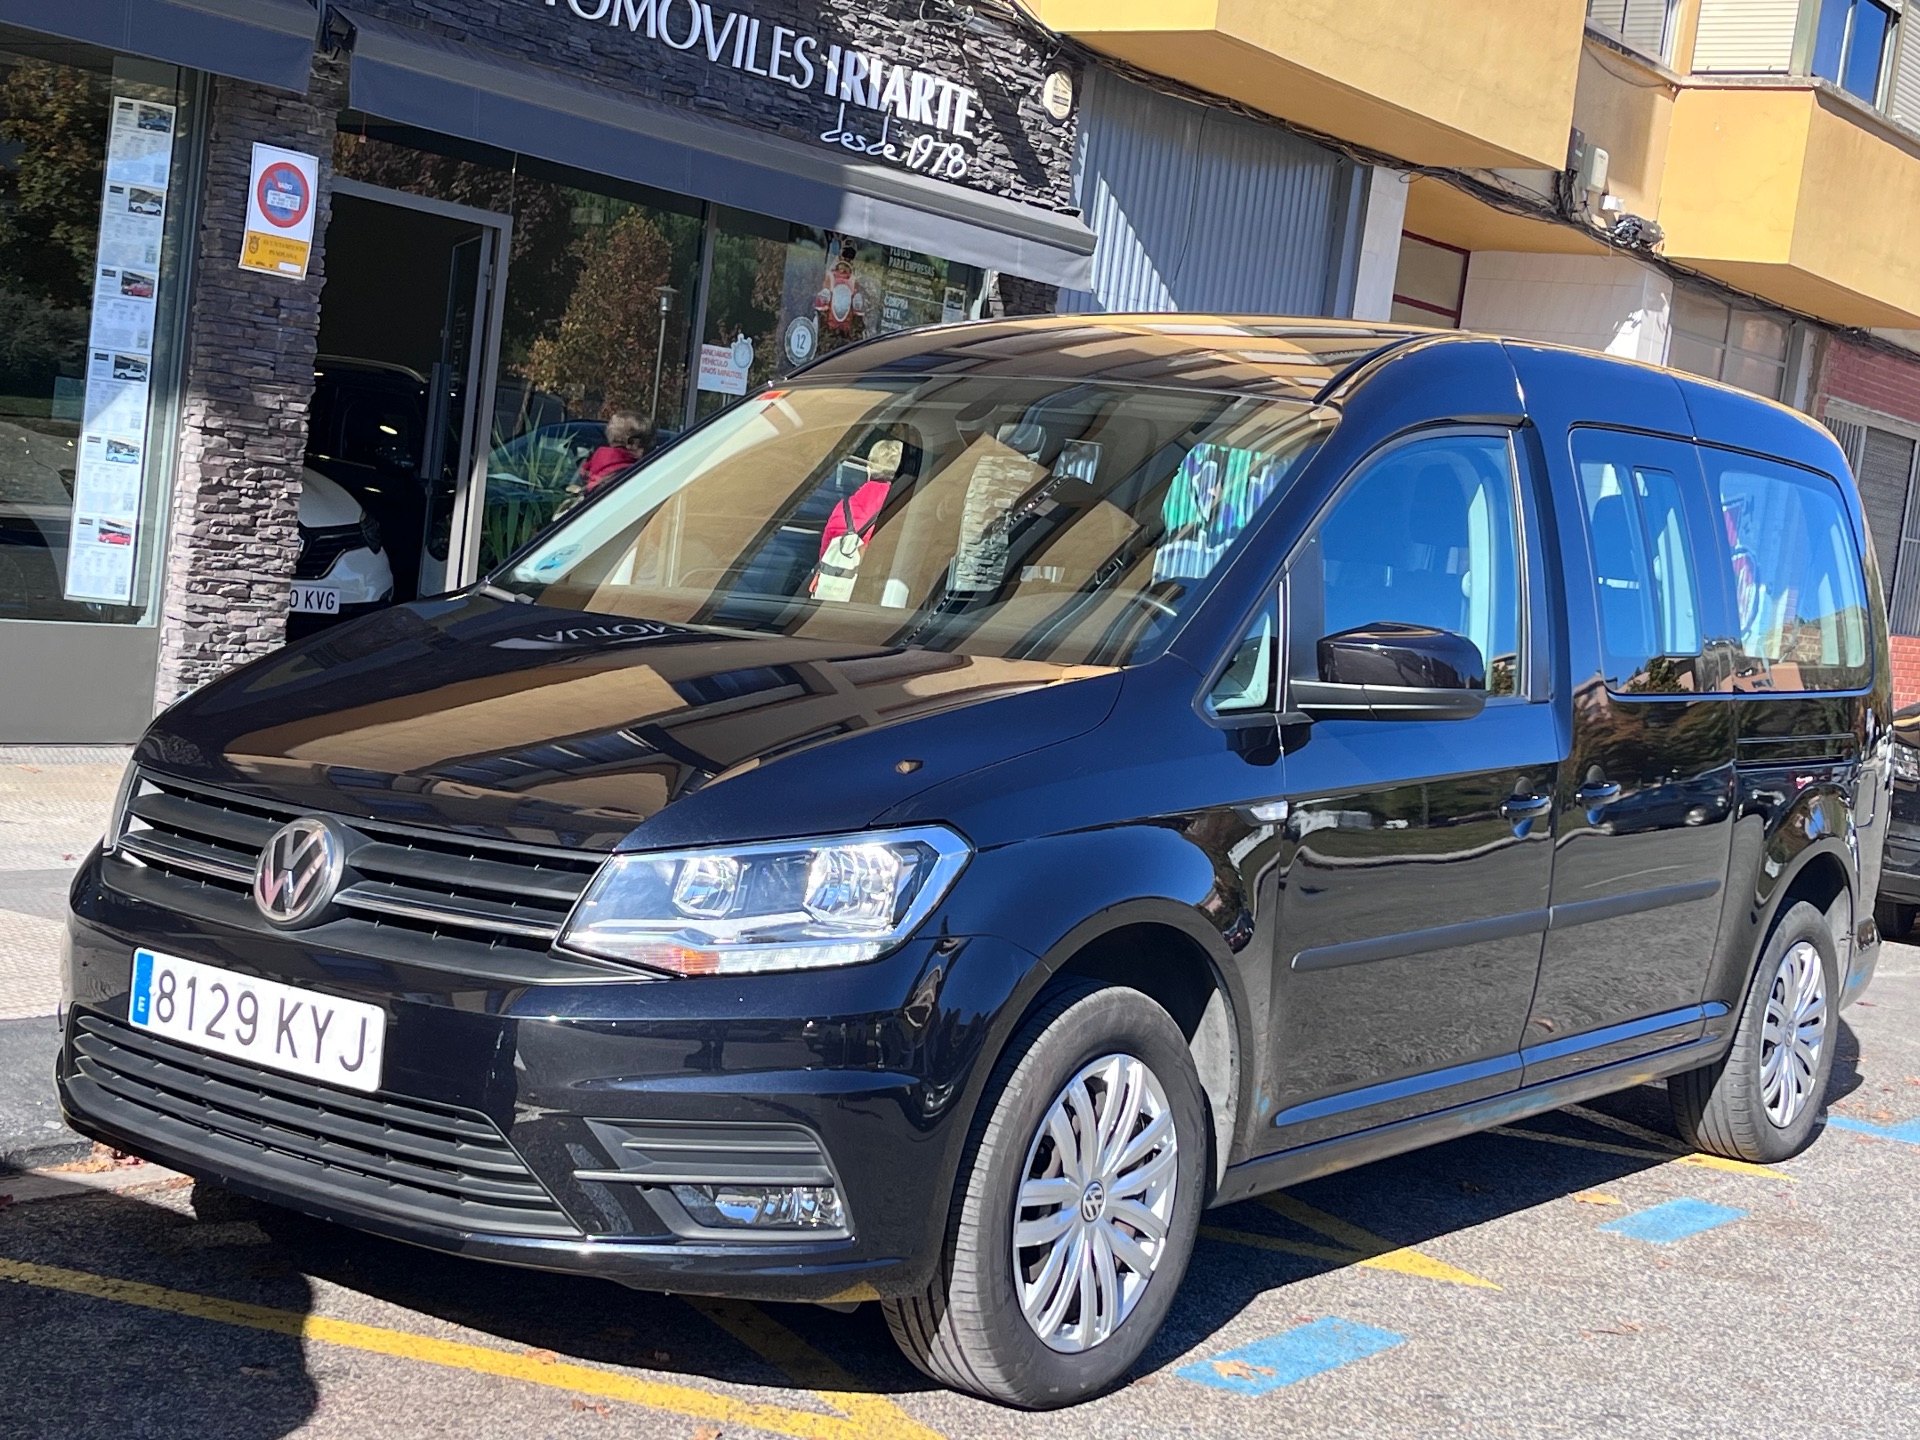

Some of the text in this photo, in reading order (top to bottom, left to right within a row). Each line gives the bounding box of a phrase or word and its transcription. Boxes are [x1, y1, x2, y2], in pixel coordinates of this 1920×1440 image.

[825, 45, 978, 139] IRIARTE
[820, 103, 966, 178] desde 1978
[889, 257, 935, 277] PARA EMPRESAS
[796, 334, 806, 350] 12
[305, 590, 335, 610] KVG
[137, 969, 367, 1072] E 8129 KYJ
